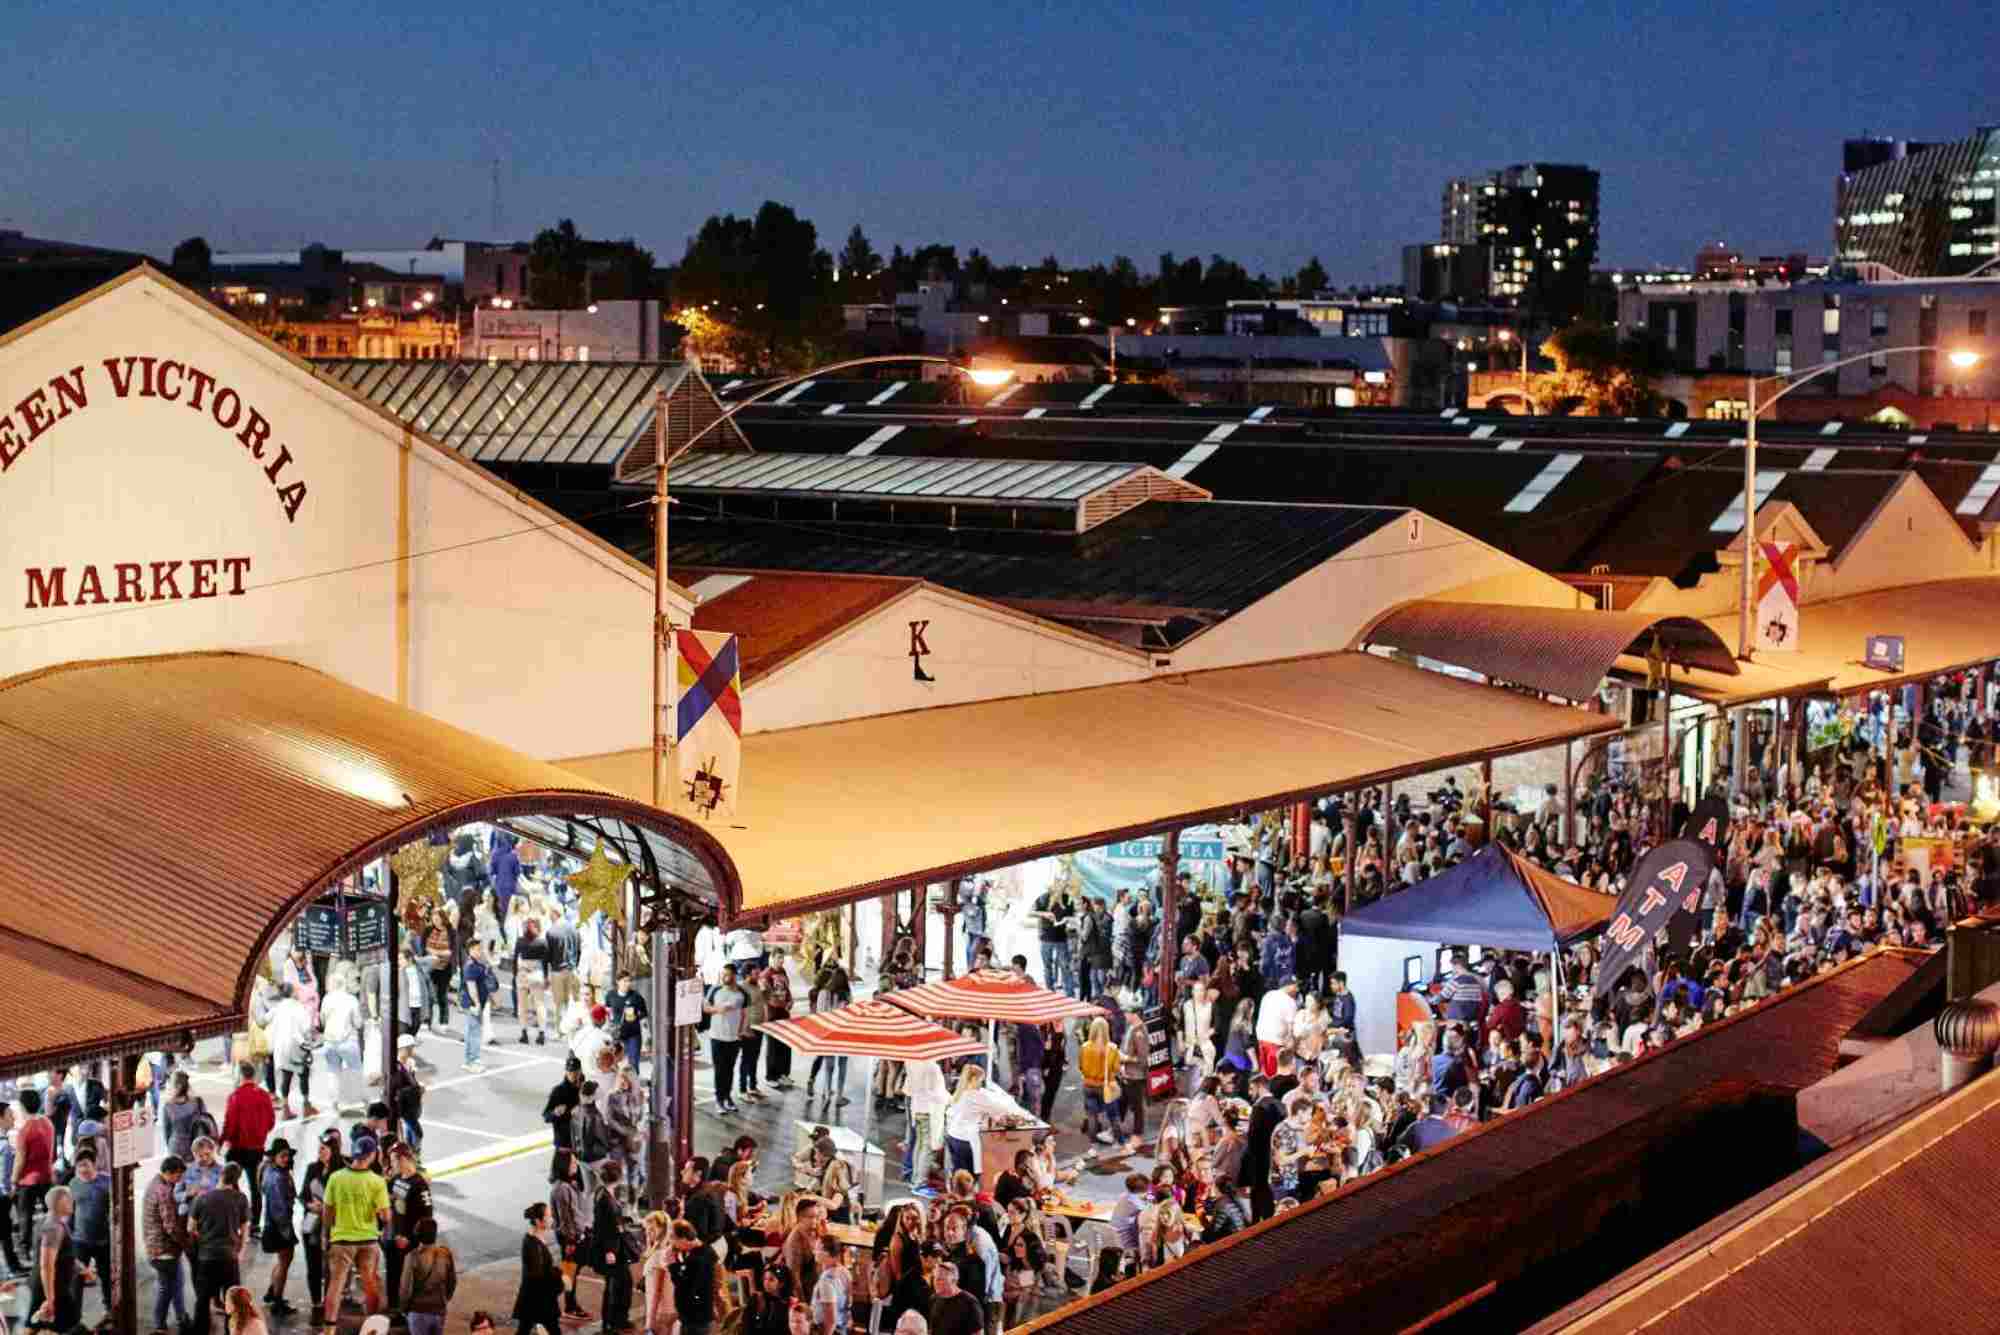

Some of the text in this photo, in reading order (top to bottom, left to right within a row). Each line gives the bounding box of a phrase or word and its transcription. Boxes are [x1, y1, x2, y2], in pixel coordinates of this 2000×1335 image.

[103, 356, 307, 523] VICTORIA
[25, 557, 251, 609] MARKET
[1607, 861, 1688, 951] ATM
